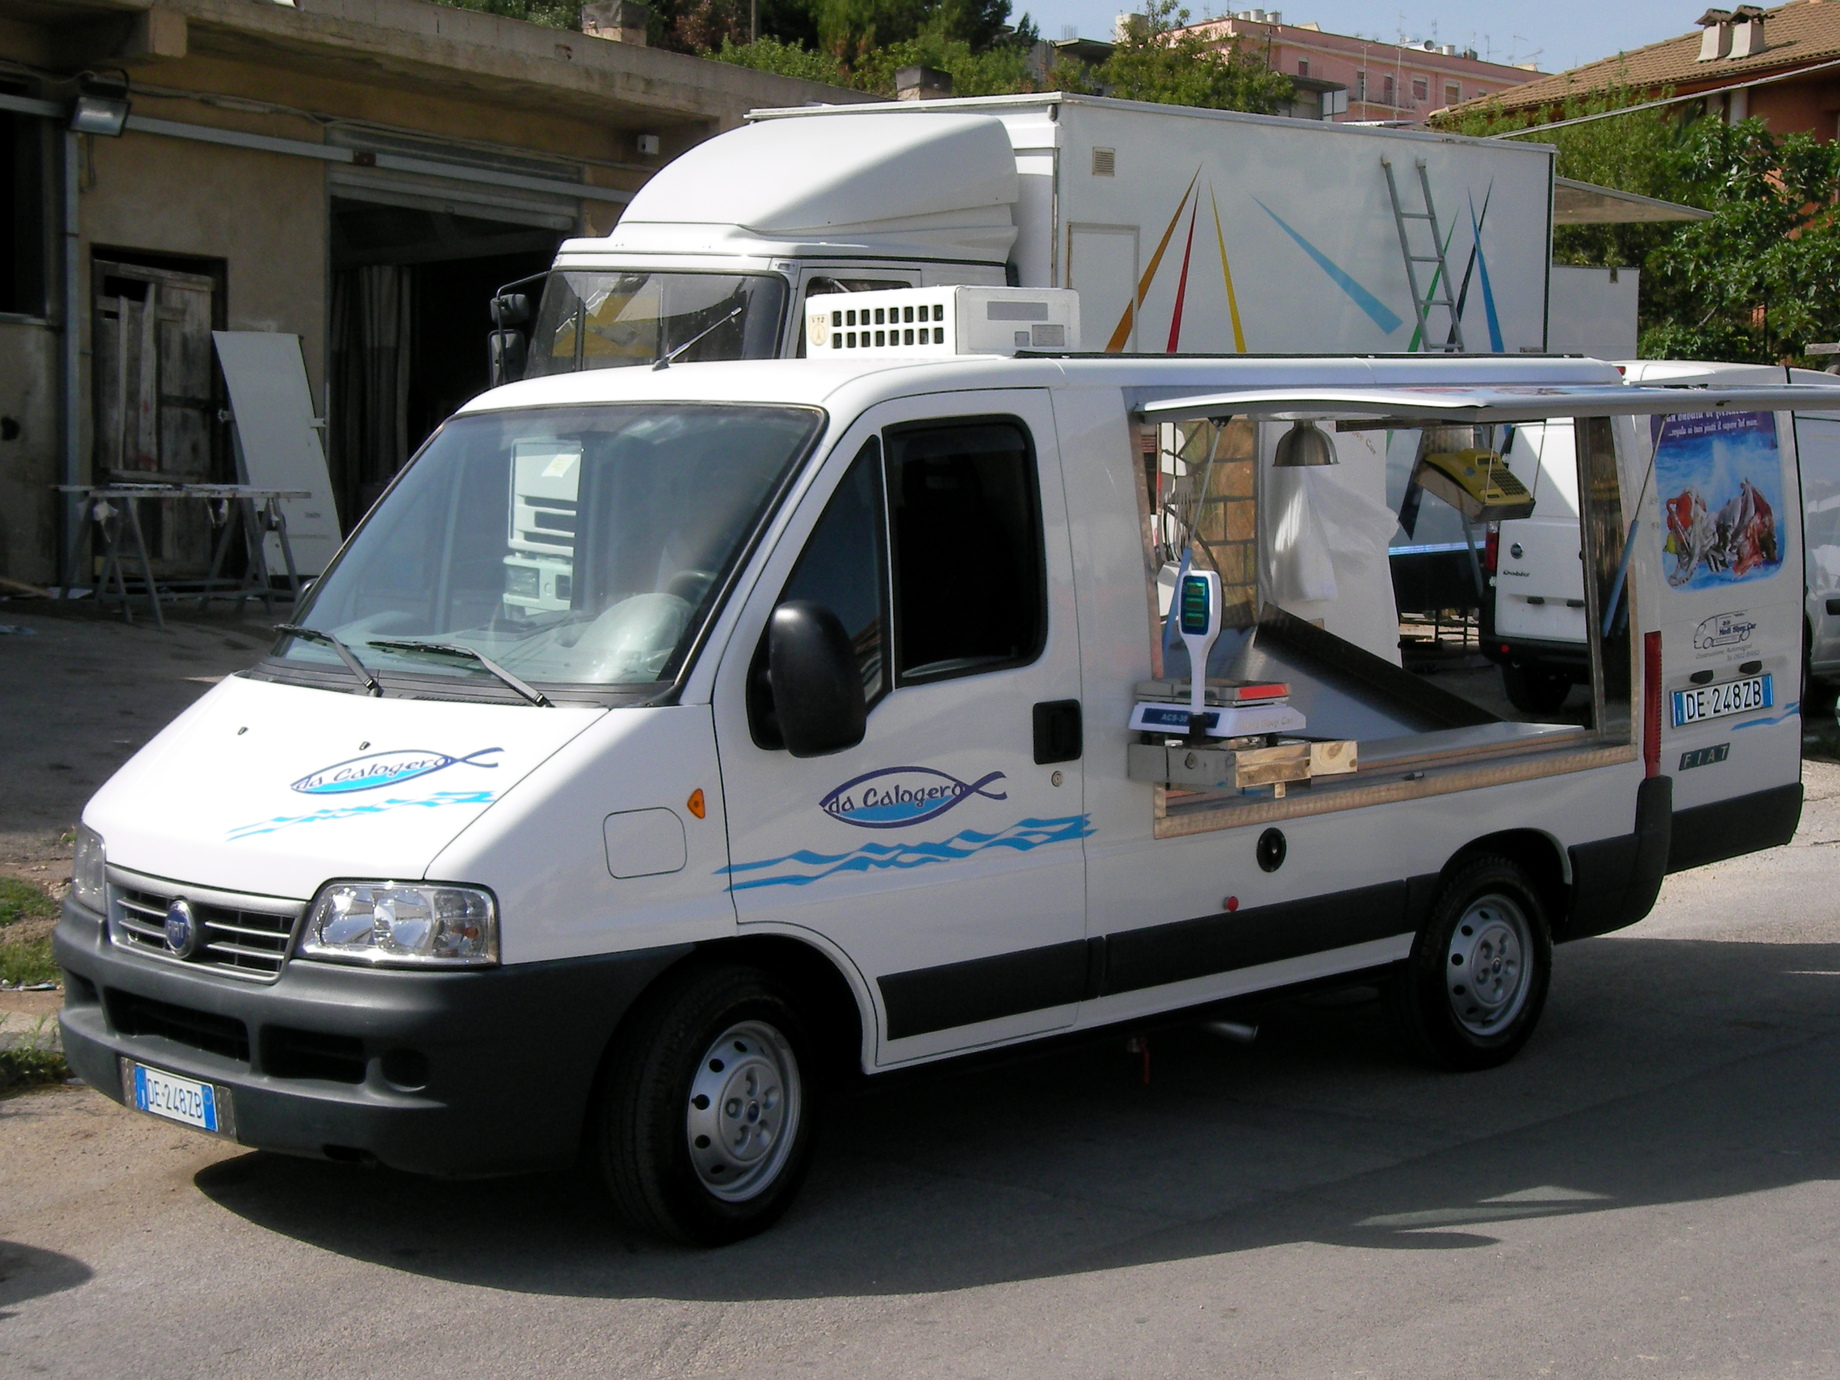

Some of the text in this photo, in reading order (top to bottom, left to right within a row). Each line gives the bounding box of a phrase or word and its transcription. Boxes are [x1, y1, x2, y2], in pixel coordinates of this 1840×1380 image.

[1683, 745, 1729, 769] FIAT
[295, 756, 451, 791] da Calogero
[828, 783, 965, 814] da Calogero
